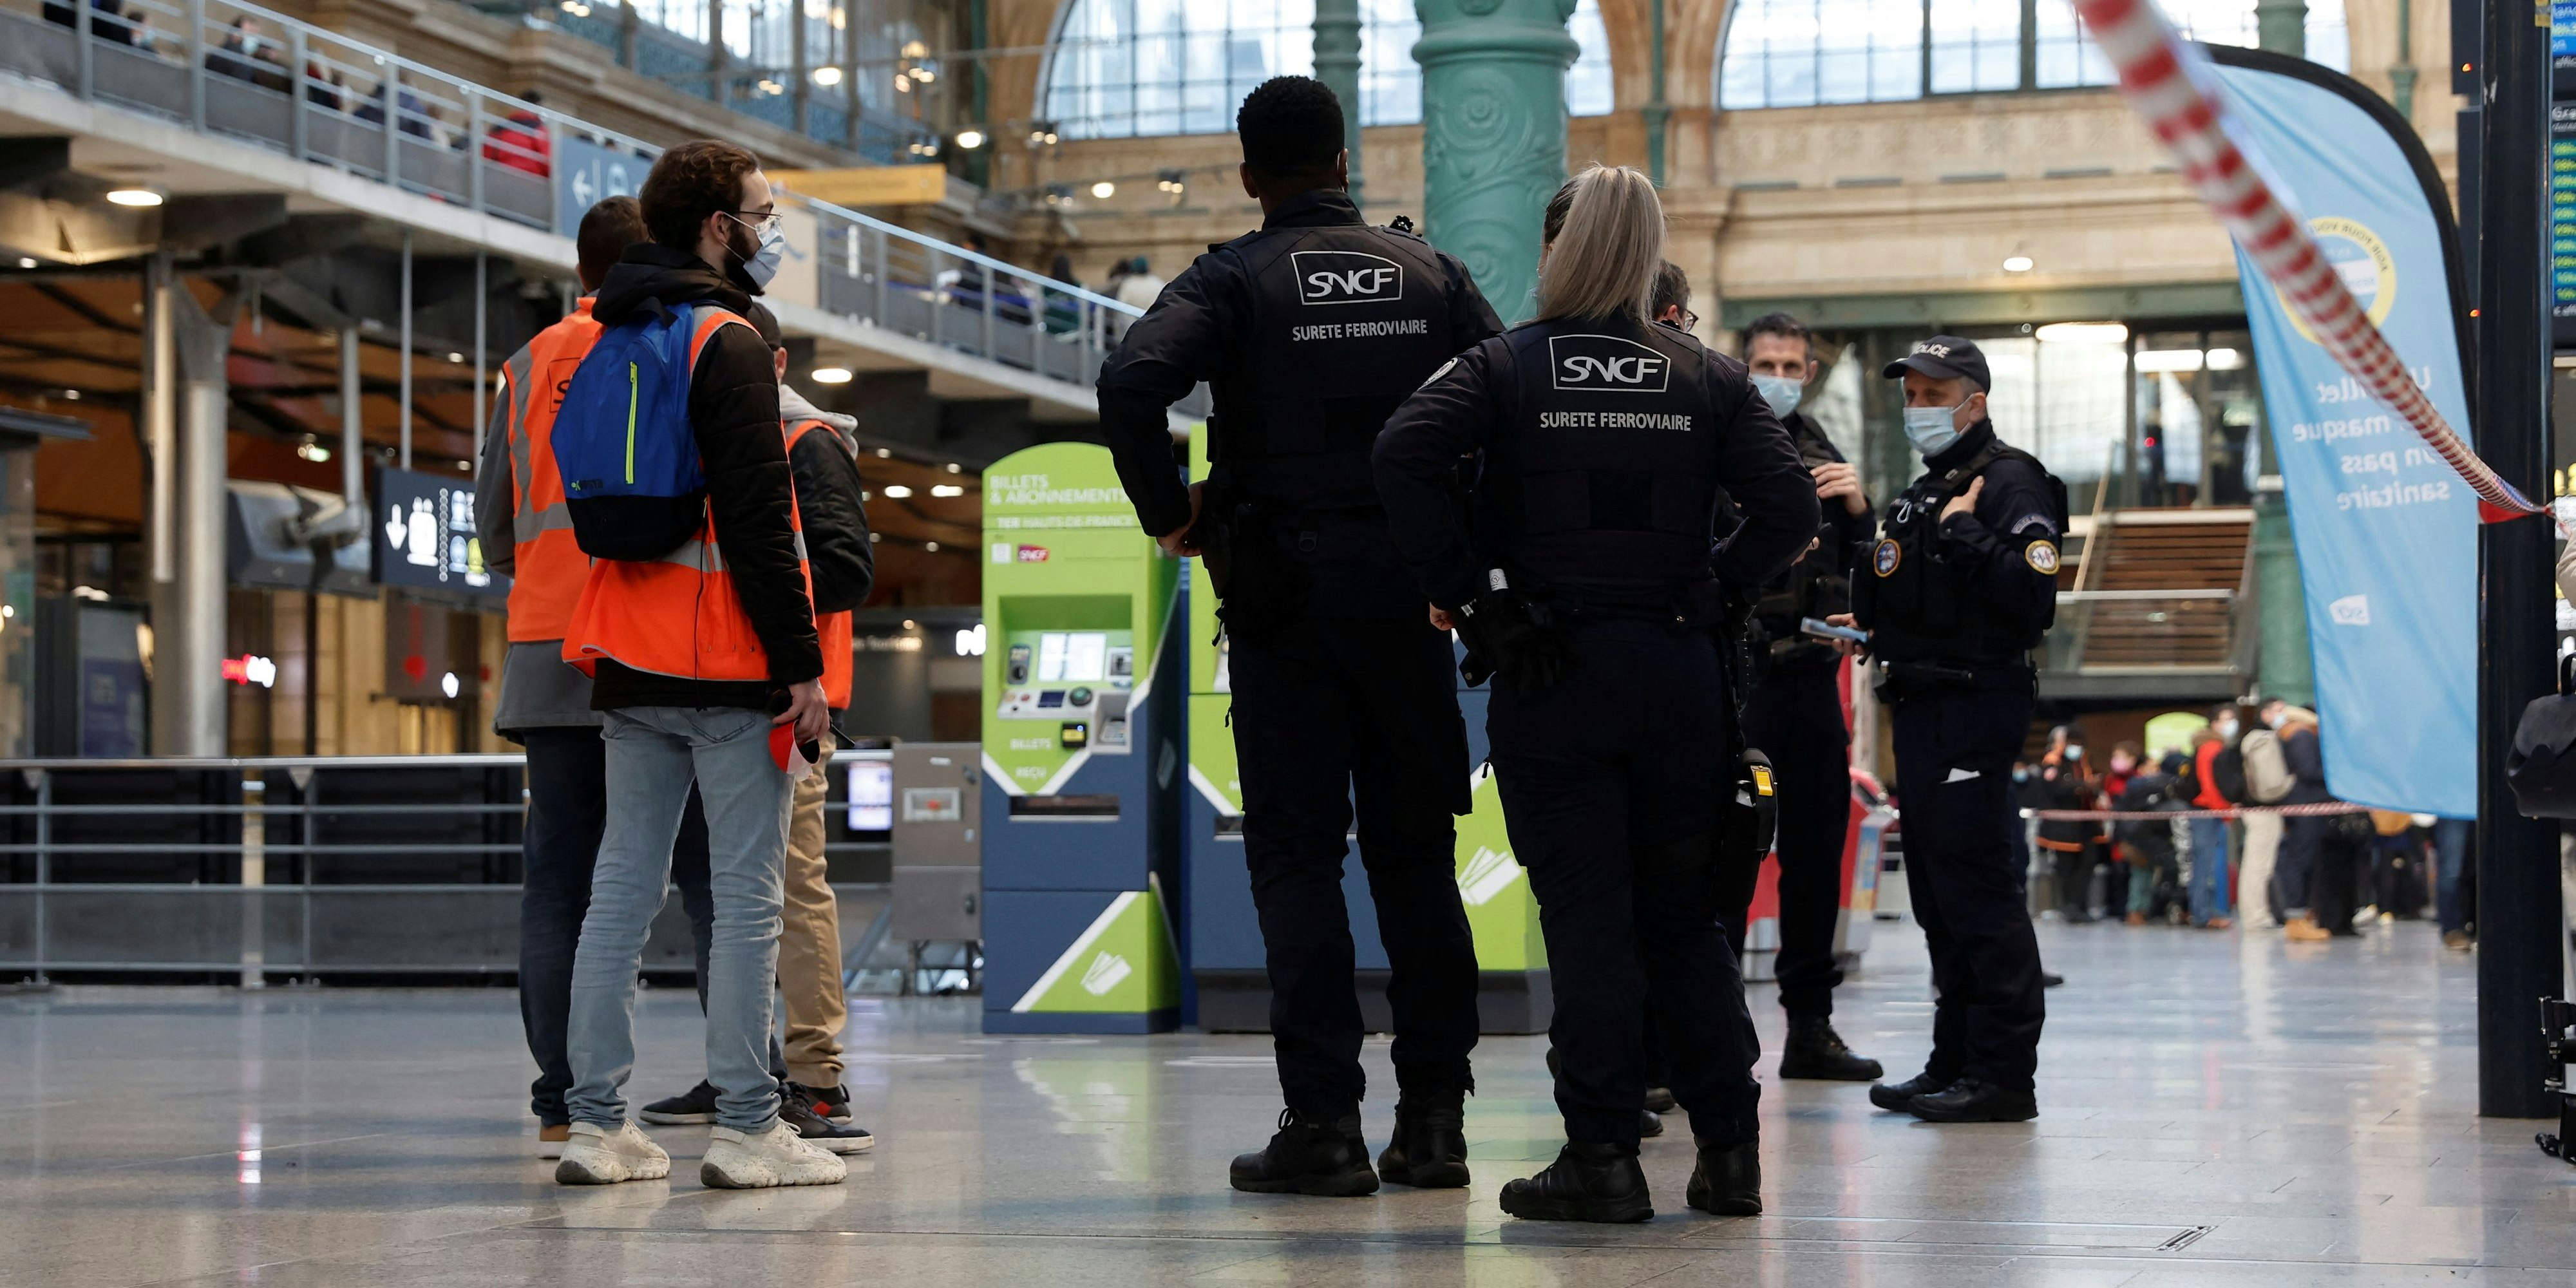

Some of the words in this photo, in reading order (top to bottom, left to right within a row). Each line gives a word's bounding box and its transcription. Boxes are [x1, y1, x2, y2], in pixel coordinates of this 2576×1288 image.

[1307, 268, 1396, 298] SNCF
[1293, 324, 1343, 341] SURETE
[1345, 319, 1427, 338] FERROVIAIRE
[1560, 356, 1663, 383] SNCF
[1540, 412, 1596, 428] SURETE
[1600, 412, 1692, 431] FERROVIAIRE
[990, 475, 1048, 489] BILLETS
[1019, 549, 1048, 561] SNCF
[1010, 738, 1052, 750] BILLETS
